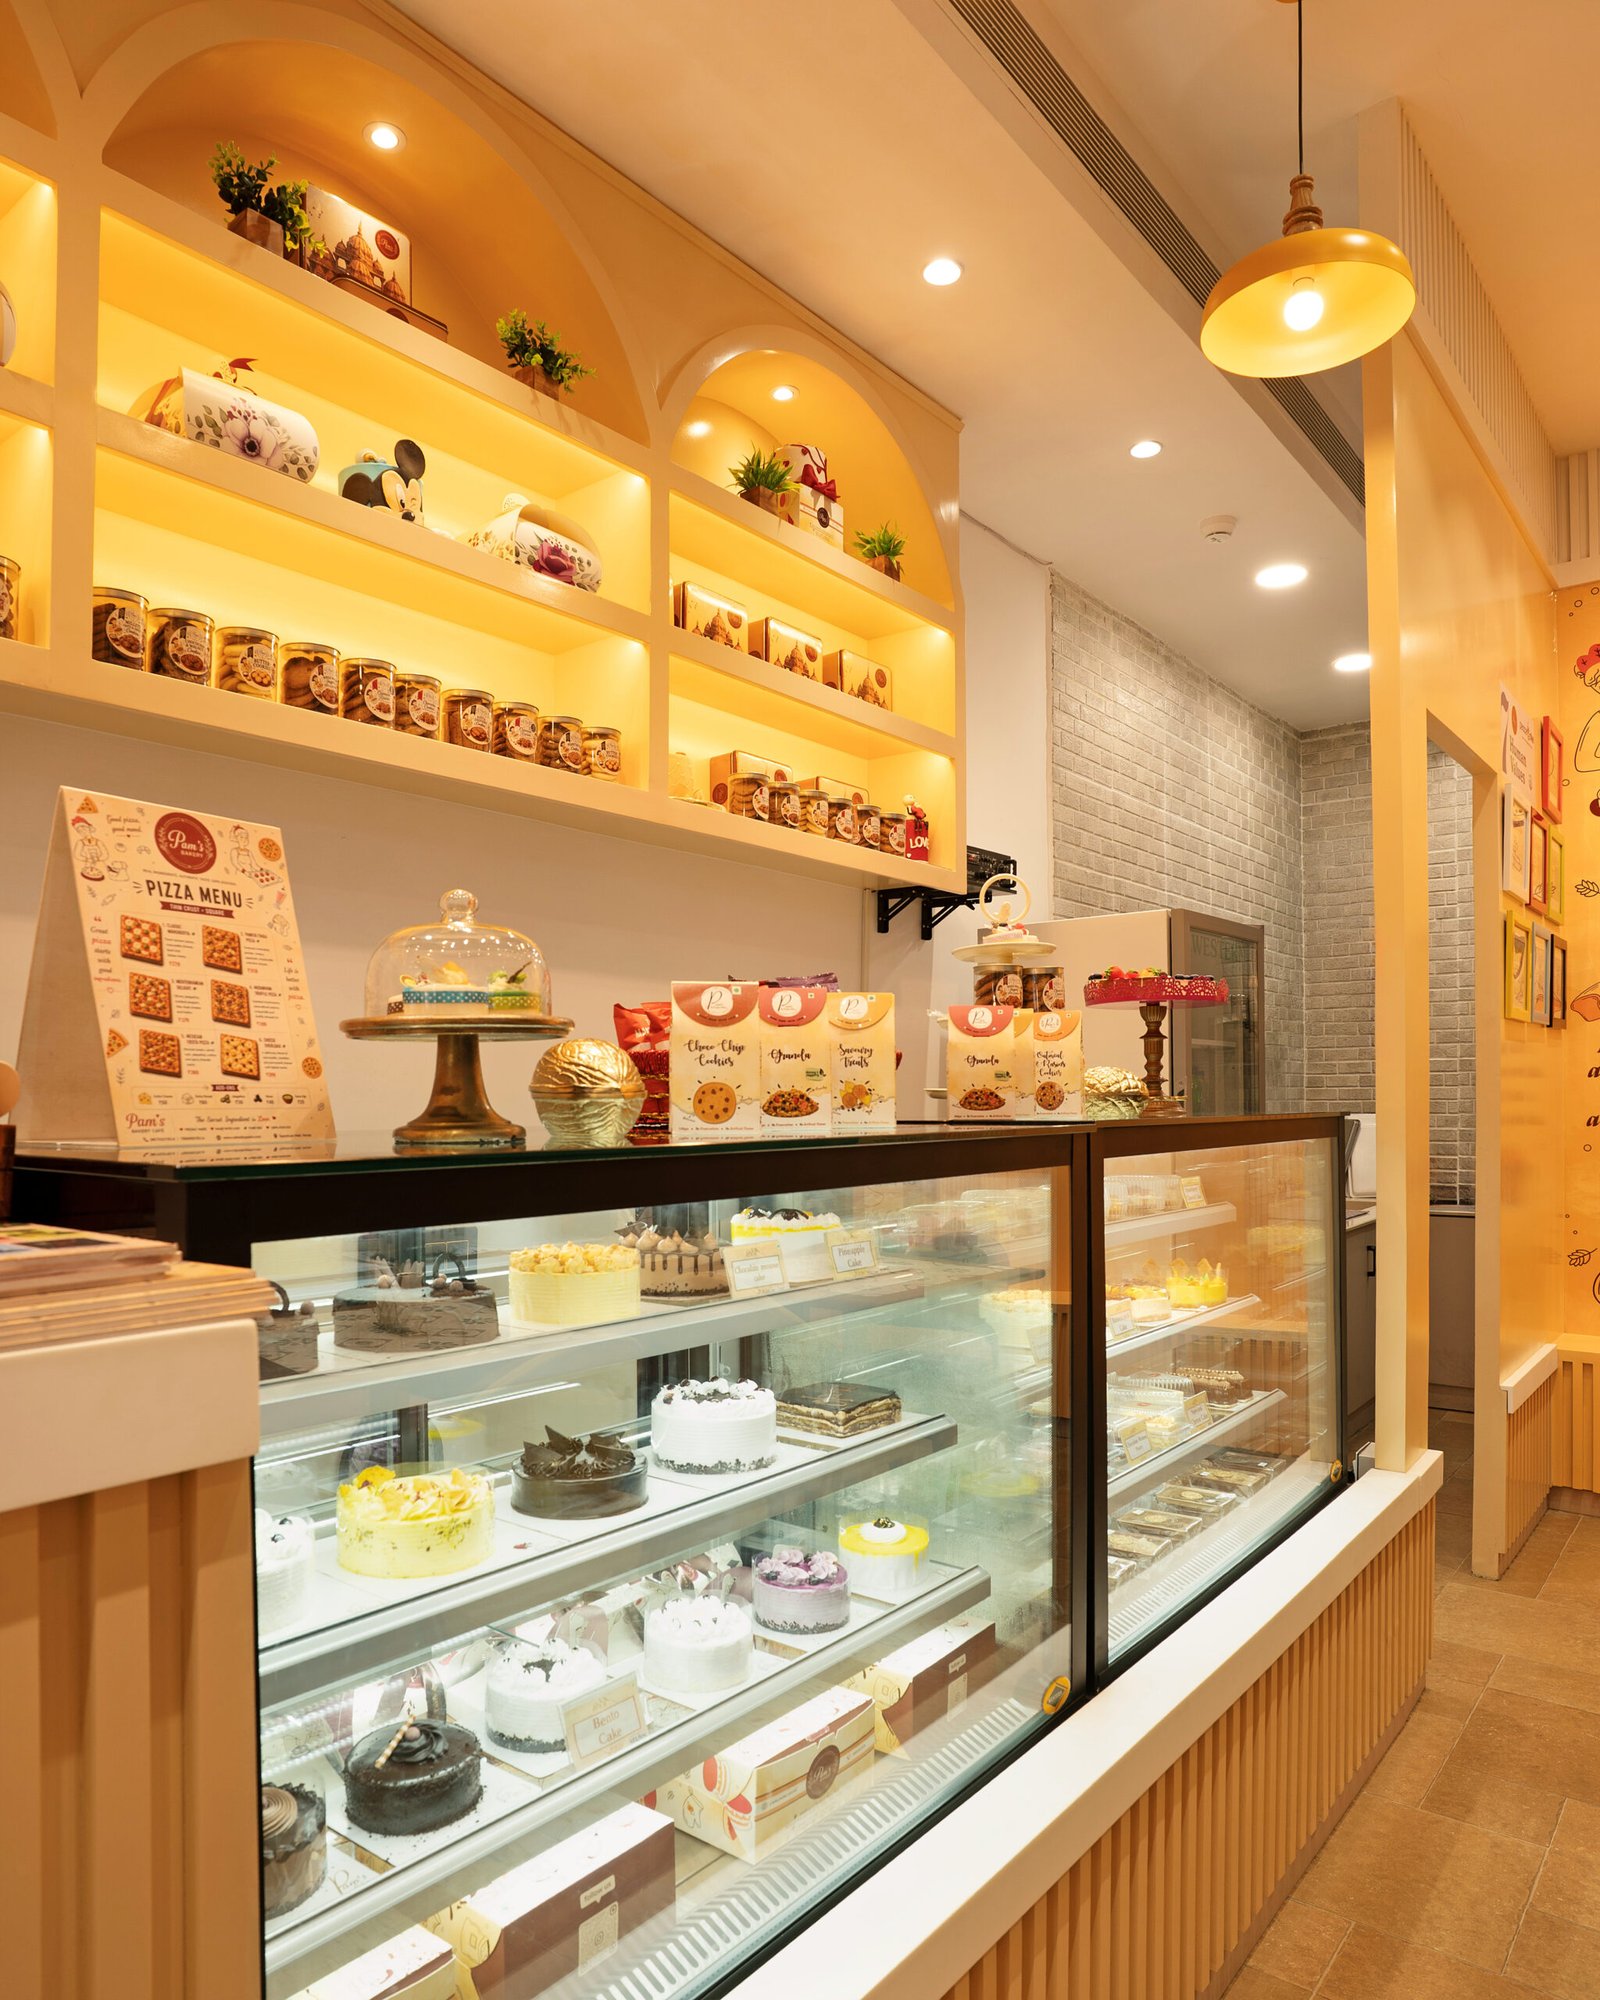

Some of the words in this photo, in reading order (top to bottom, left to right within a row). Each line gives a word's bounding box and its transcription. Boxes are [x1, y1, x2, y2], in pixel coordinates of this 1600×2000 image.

[167, 829, 205, 853] Pam's
[145, 879, 195, 901] PIZZA
[198, 886, 242, 908] MENU
[683, 1039, 715, 1052] Choco
[717, 1039, 745, 1055] Chip
[838, 1043, 873, 1058] Savoury
[694, 1053, 734, 1067] Cookies
[767, 1048, 811, 1064] Granola
[964, 1054, 999, 1067] Granola
[126, 1112, 166, 1129] Pam's
[847, 1257, 863, 1268] Cake
[592, 1710, 620, 1729] Bento
[598, 1727, 622, 1746] Cake
